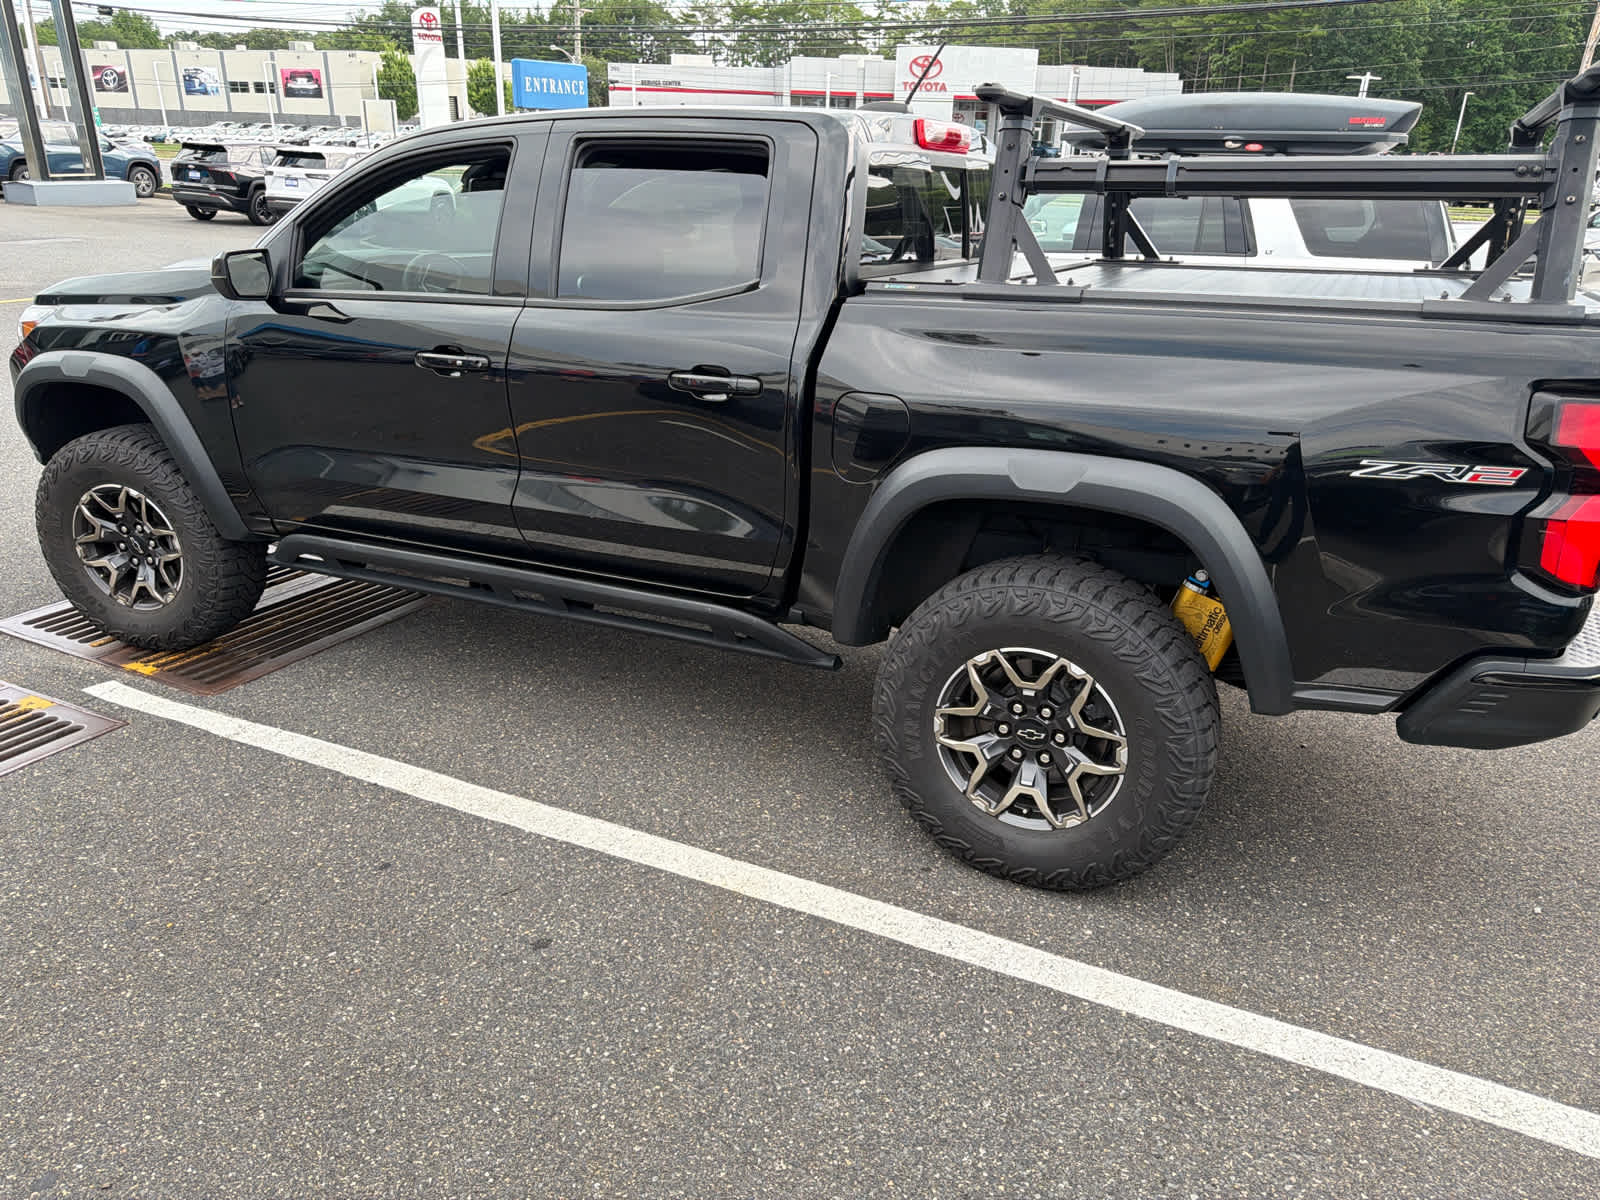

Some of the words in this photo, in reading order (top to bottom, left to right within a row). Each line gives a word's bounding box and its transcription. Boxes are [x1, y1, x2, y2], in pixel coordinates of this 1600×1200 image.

[417, 33, 442, 42] TOYOTA
[525, 76, 585, 95] ENTRANCE
[903, 82, 948, 92] TOYOTA
[1349, 459, 1529, 486] ZR2
